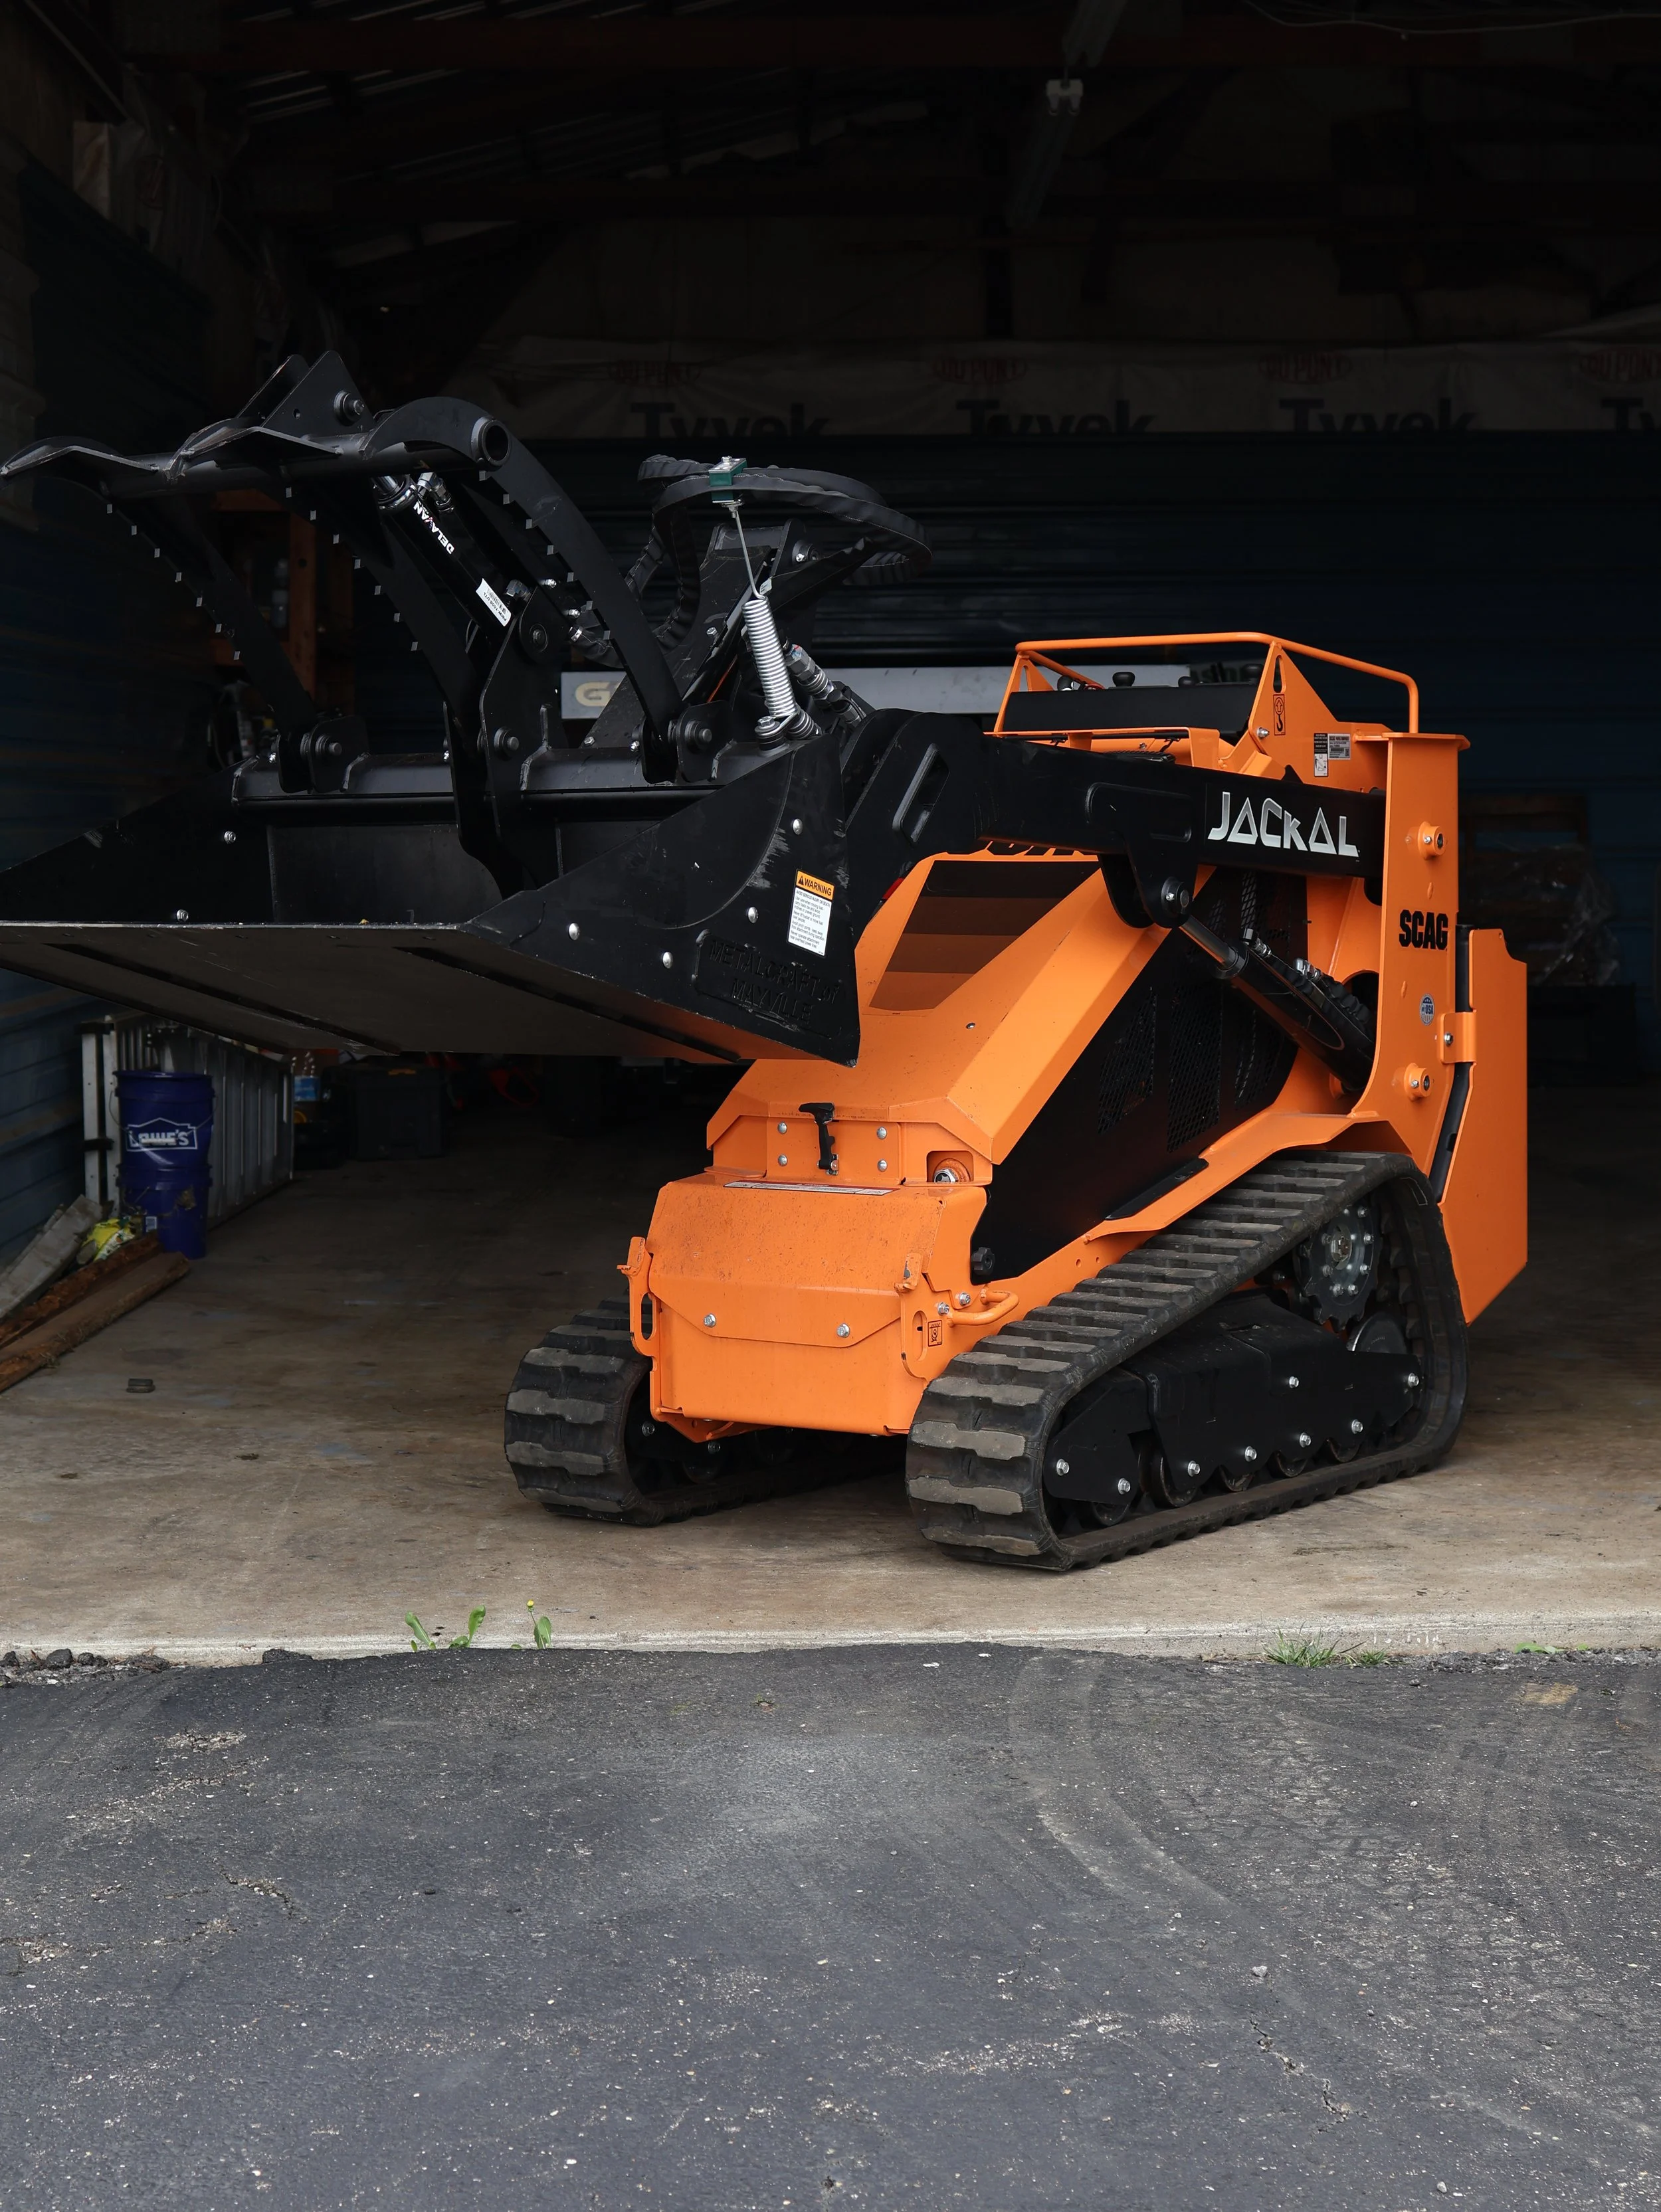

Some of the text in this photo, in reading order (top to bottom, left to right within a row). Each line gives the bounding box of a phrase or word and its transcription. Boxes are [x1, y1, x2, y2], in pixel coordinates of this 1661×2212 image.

[413, 501, 454, 555] DELAVAN
[1207, 791, 1359, 858] JACKAL
[805, 877, 832, 896] WARNING
[1399, 909, 1448, 950] SCAG
[129, 1129, 190, 1147] LOWE'S
